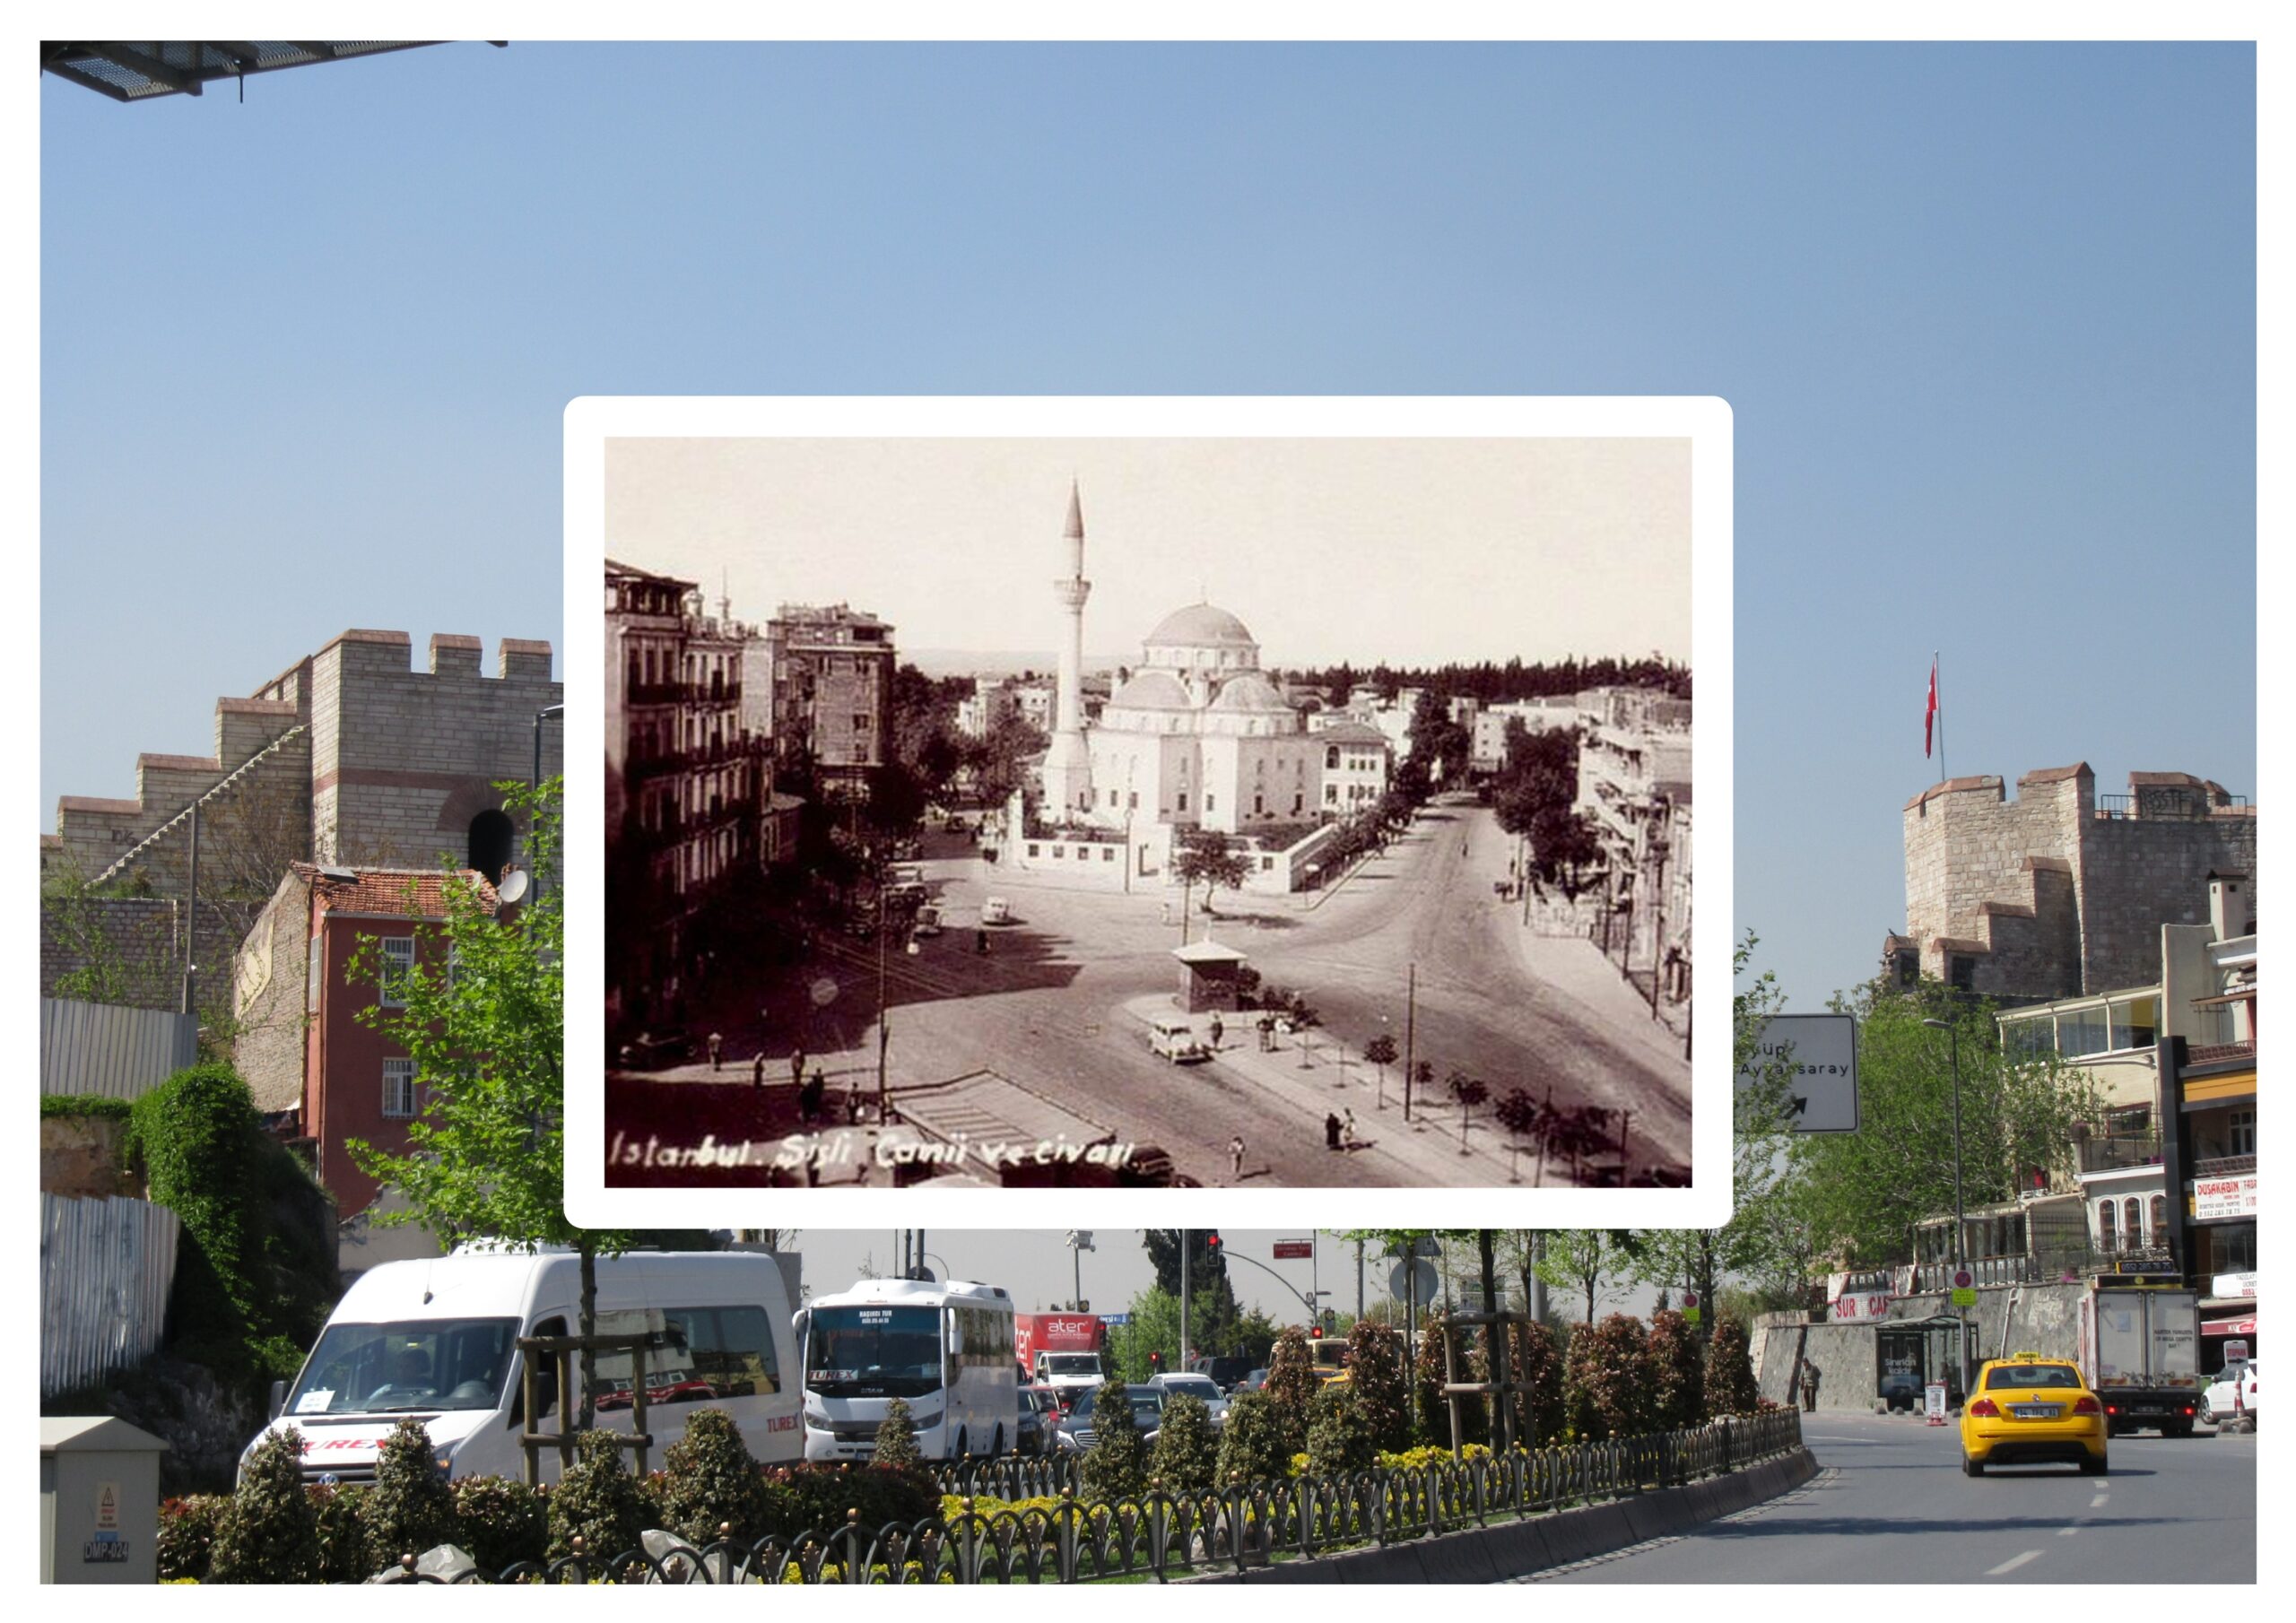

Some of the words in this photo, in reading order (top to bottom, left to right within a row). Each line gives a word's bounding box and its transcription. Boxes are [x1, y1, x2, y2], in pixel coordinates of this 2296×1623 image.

[1740, 1063, 1848, 1077] Ayvasaray
[981, 1143, 1025, 1167] ve
[1836, 1298, 1856, 1318] SUR
[1048, 1318, 1086, 1332] ater
[809, 1370, 853, 1381] TUREX
[767, 1412, 798, 1433] TUREX
[303, 1439, 387, 1451] UREX
[85, 1542, 128, 1558] DMP-024
